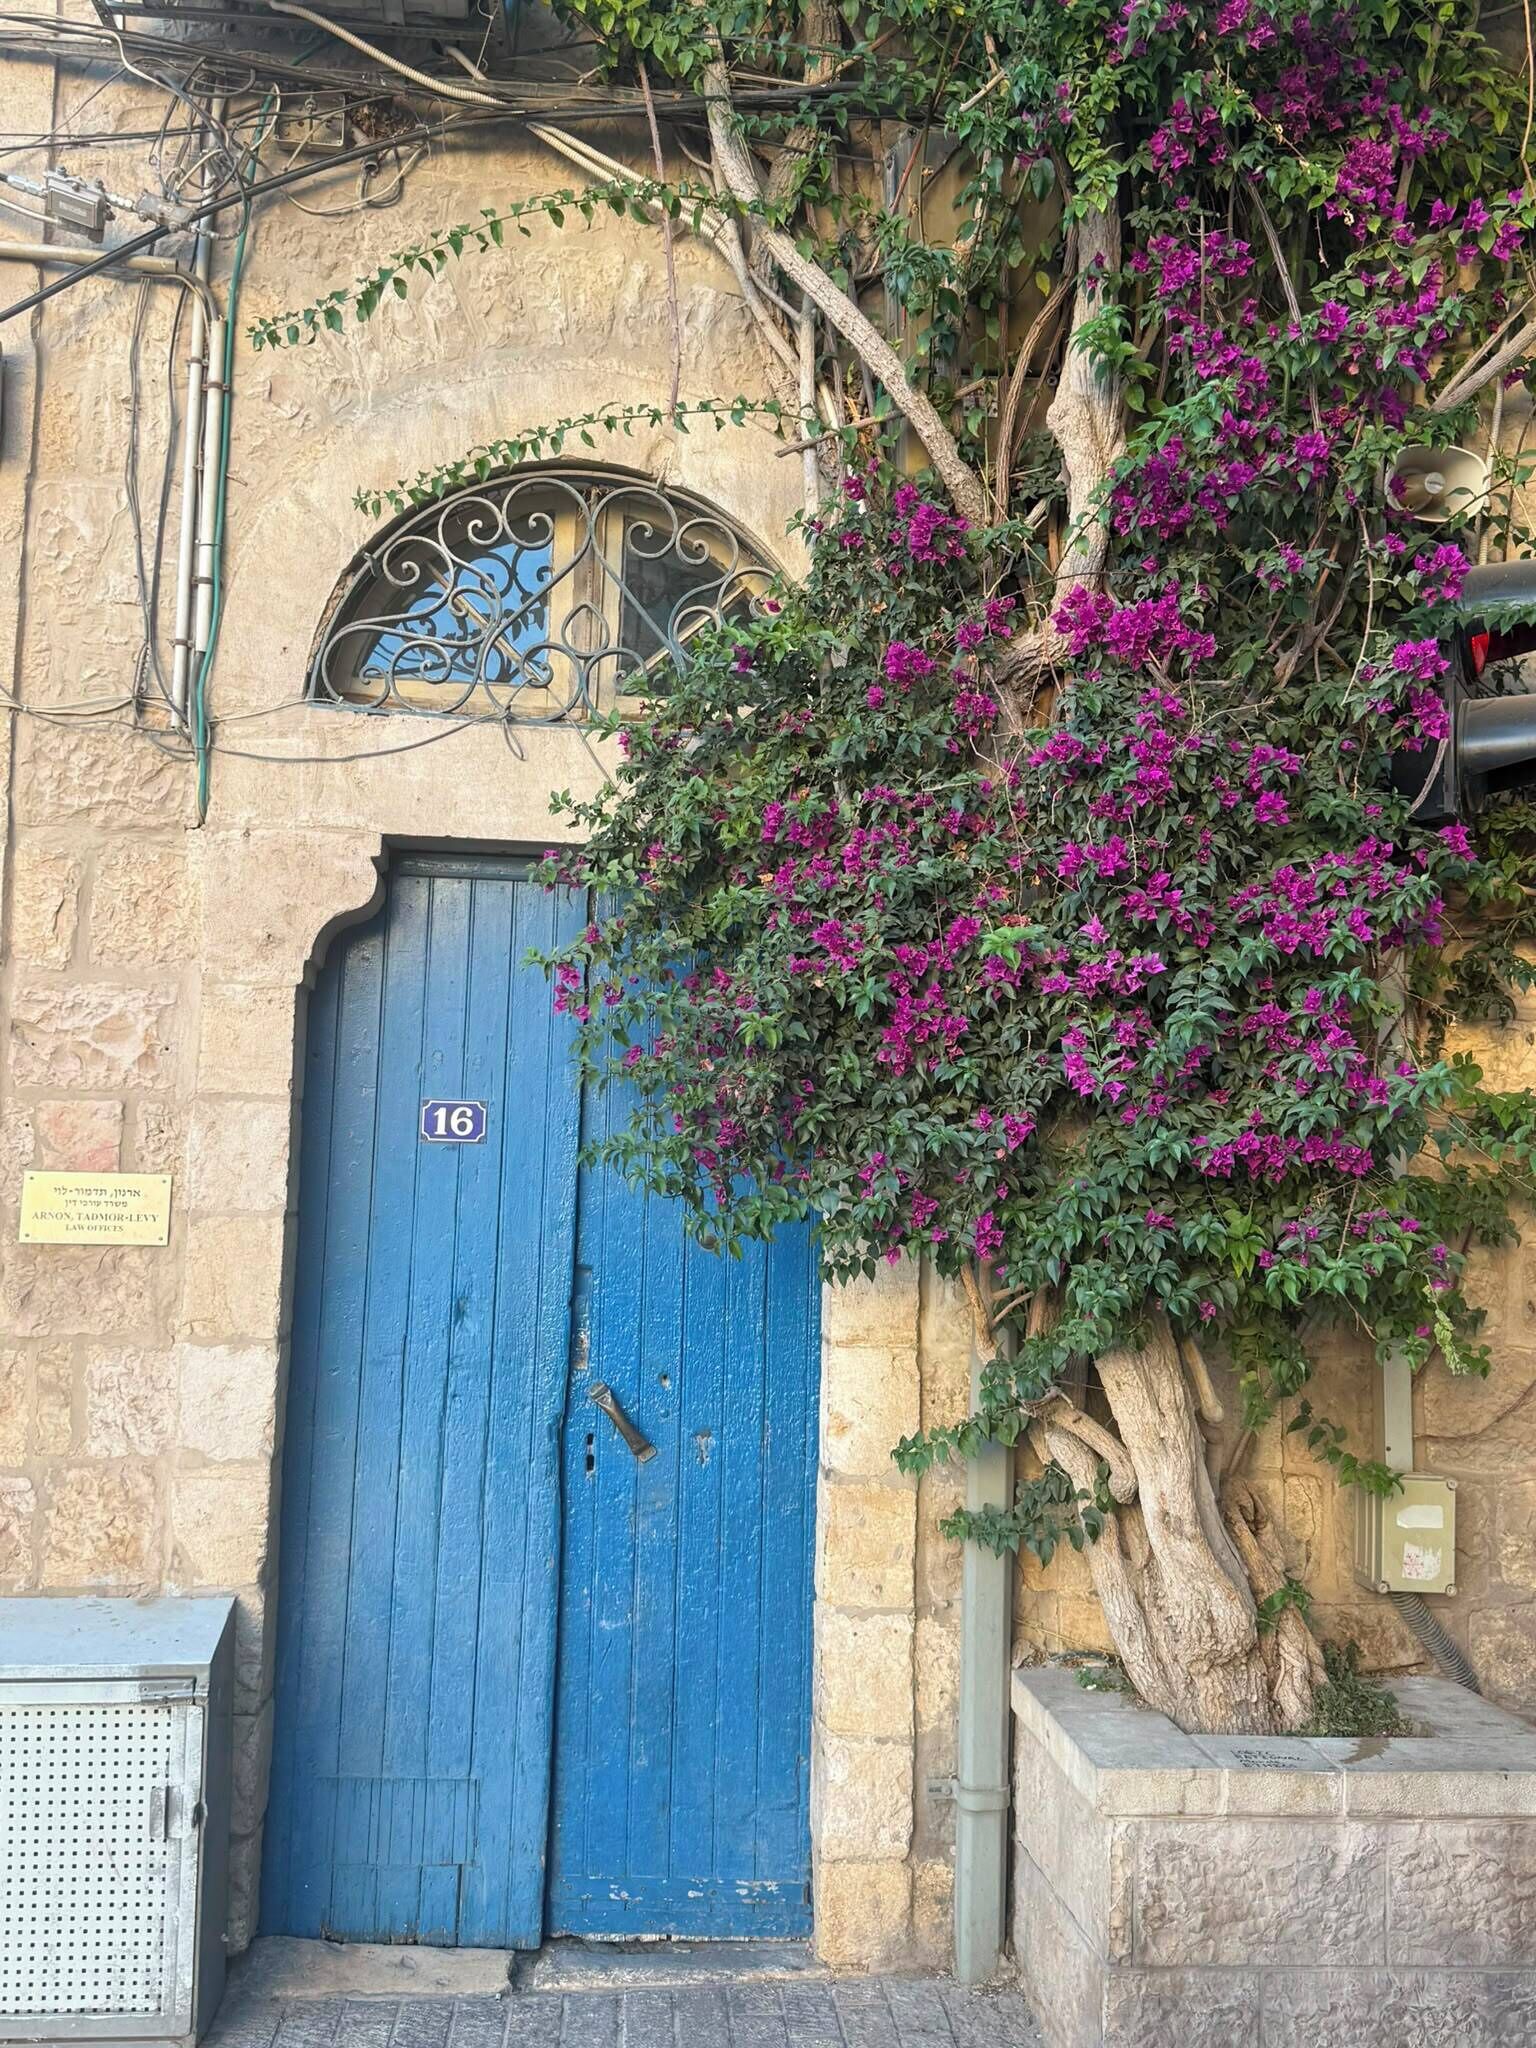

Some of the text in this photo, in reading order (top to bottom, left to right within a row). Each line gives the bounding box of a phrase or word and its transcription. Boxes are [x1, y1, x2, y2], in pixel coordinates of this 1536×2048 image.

[433, 1106, 474, 1136] 16
[65, 1199, 77, 1208] דין
[32, 1211, 74, 1221] ARNON,
[65, 1223, 84, 1232] LAW
